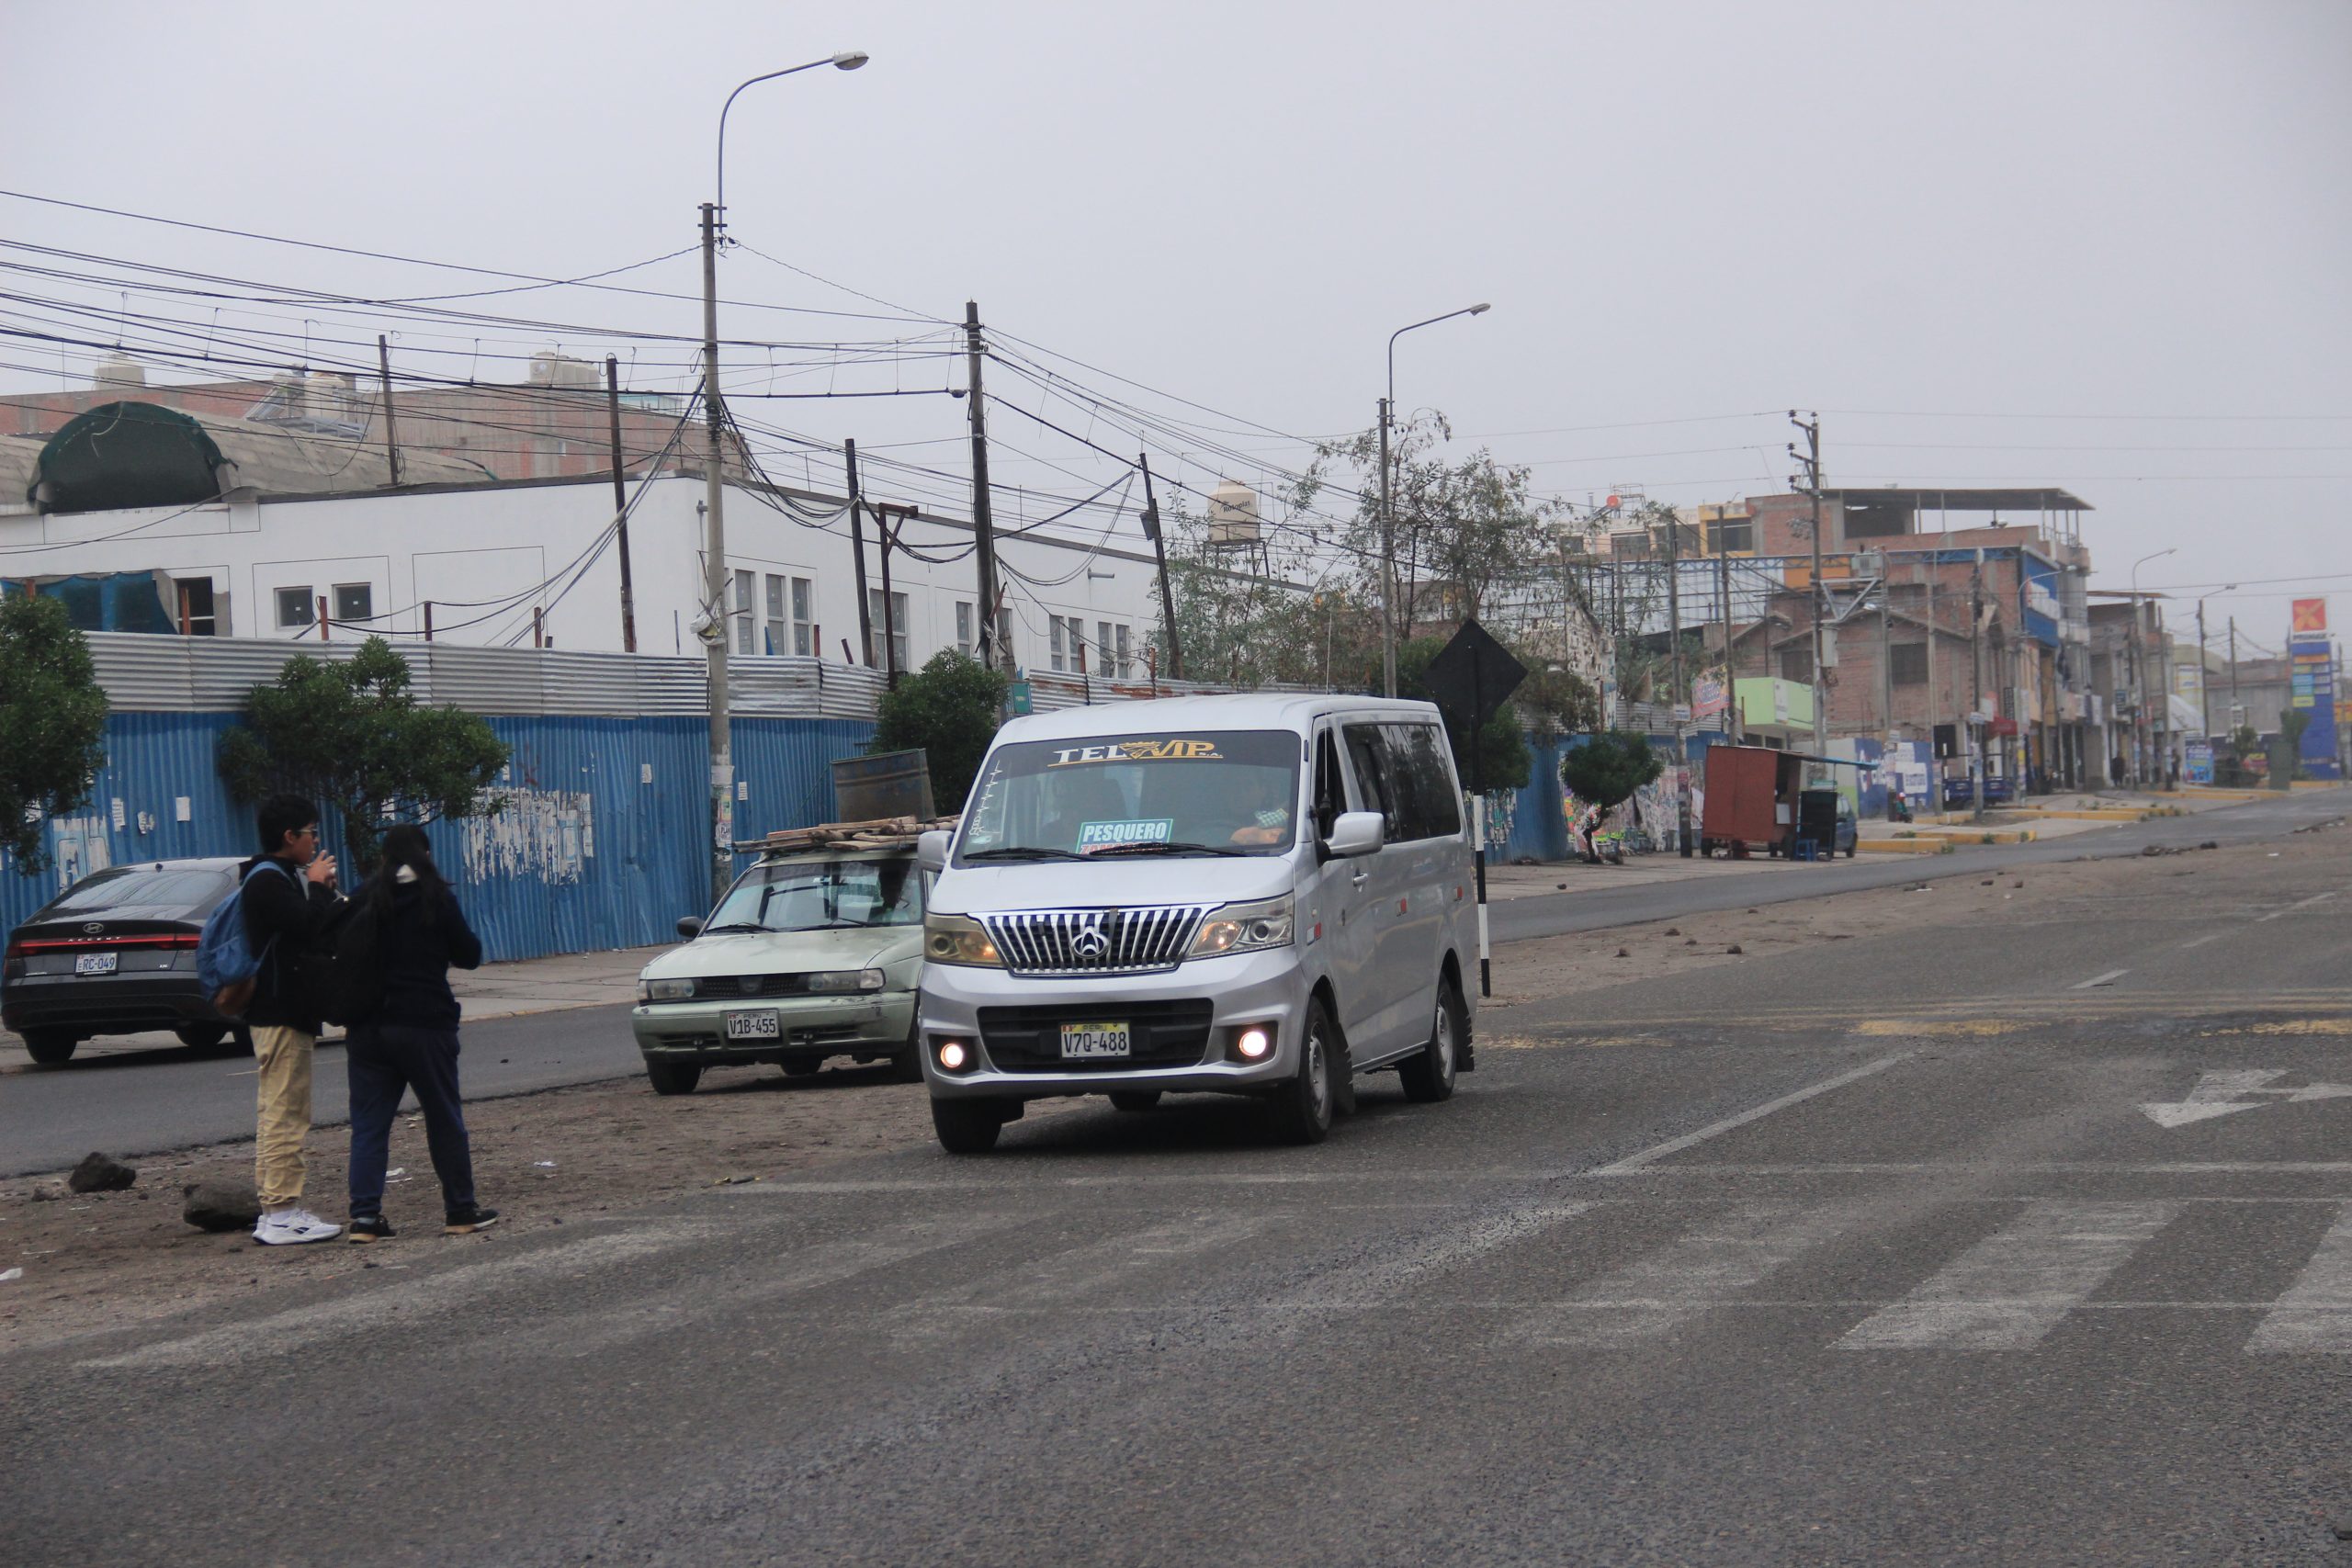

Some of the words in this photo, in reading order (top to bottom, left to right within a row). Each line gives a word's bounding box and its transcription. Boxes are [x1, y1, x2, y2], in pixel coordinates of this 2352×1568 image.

[1082, 822, 1168, 842] PESQUERO
[729, 1018, 776, 1034] V1B-455
[1064, 1032, 1127, 1053] V7Q-488
